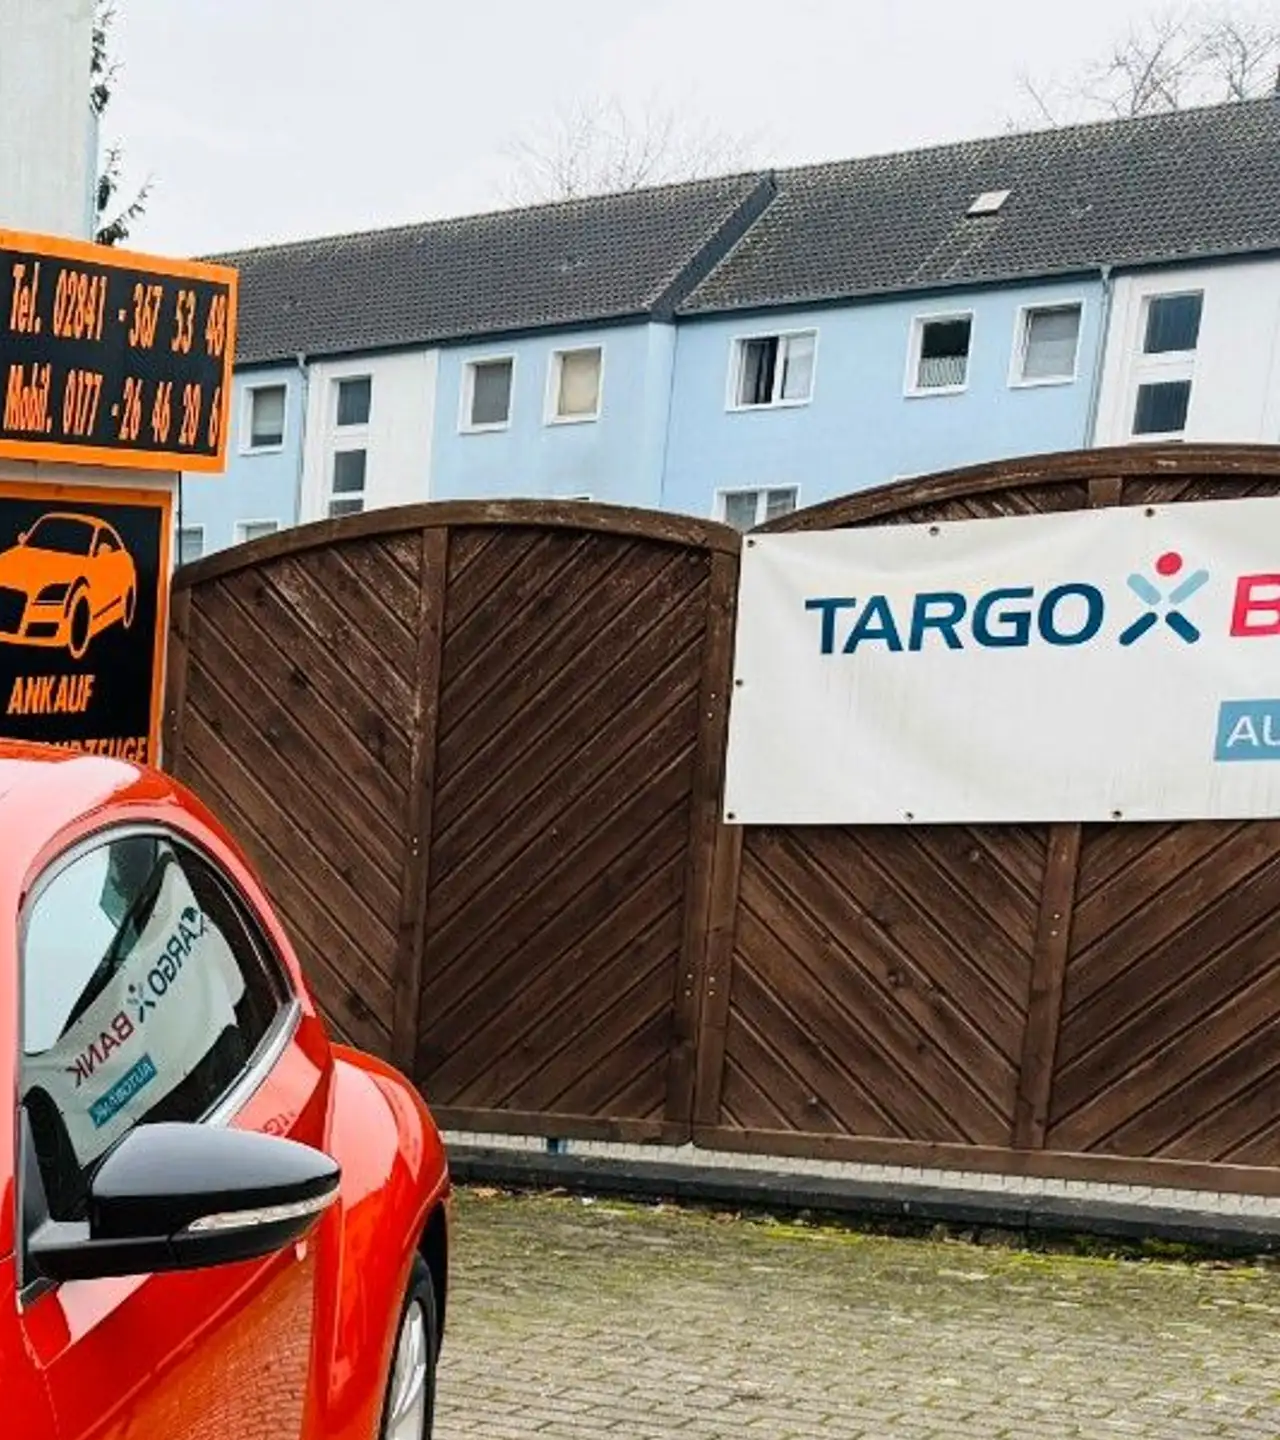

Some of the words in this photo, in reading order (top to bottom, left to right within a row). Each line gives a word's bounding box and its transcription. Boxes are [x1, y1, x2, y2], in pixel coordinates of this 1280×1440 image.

[10, 261, 41, 334] Tel.
[53, 268, 108, 341] 02841
[129, 283, 164, 348] 367
[171, 290, 196, 353] 53
[205, 294, 226, 356] 48
[3, 362, 53, 434] Mobil.
[63, 369, 103, 436] 0177
[118, 376, 143, 440] 26
[152, 381, 173, 443] 46
[178, 383, 201, 445] 20
[208, 386, 220, 447] 6
[804, 582, 1105, 655] TARGO
[6, 674, 95, 715] ANKAUF
